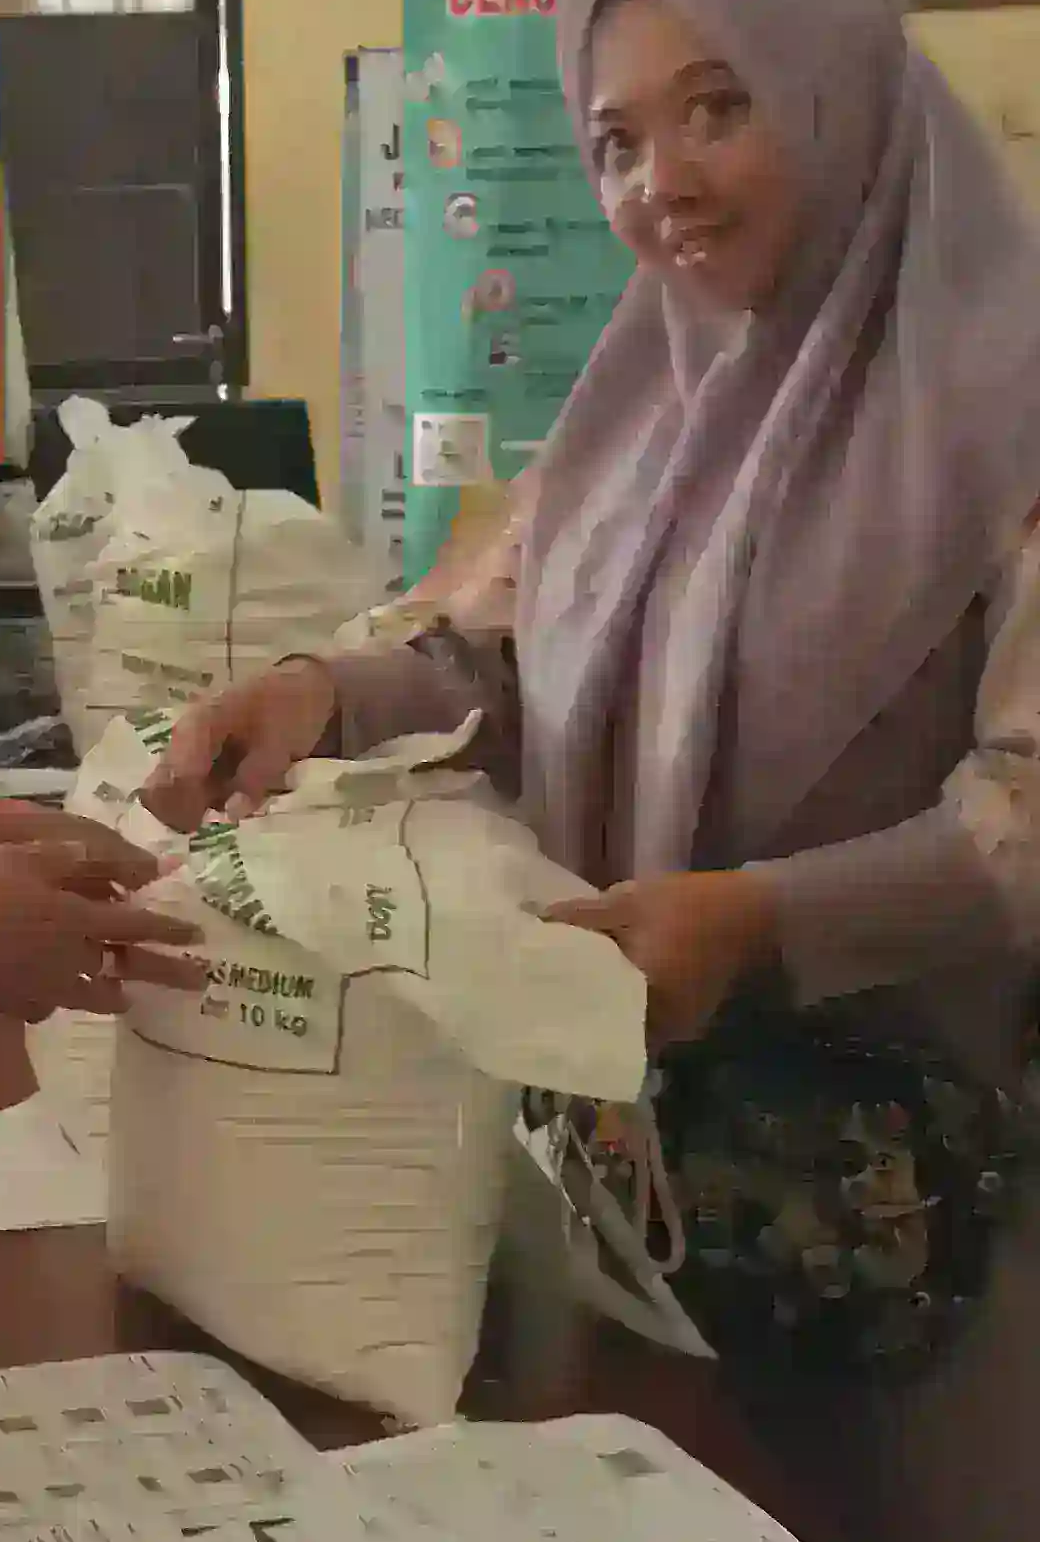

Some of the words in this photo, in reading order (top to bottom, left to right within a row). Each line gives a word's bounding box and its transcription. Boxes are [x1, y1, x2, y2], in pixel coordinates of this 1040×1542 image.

[229, 963, 315, 1000] MEDIUM
[240, 1002, 265, 1027] 10
[274, 1008, 308, 1038] kg
